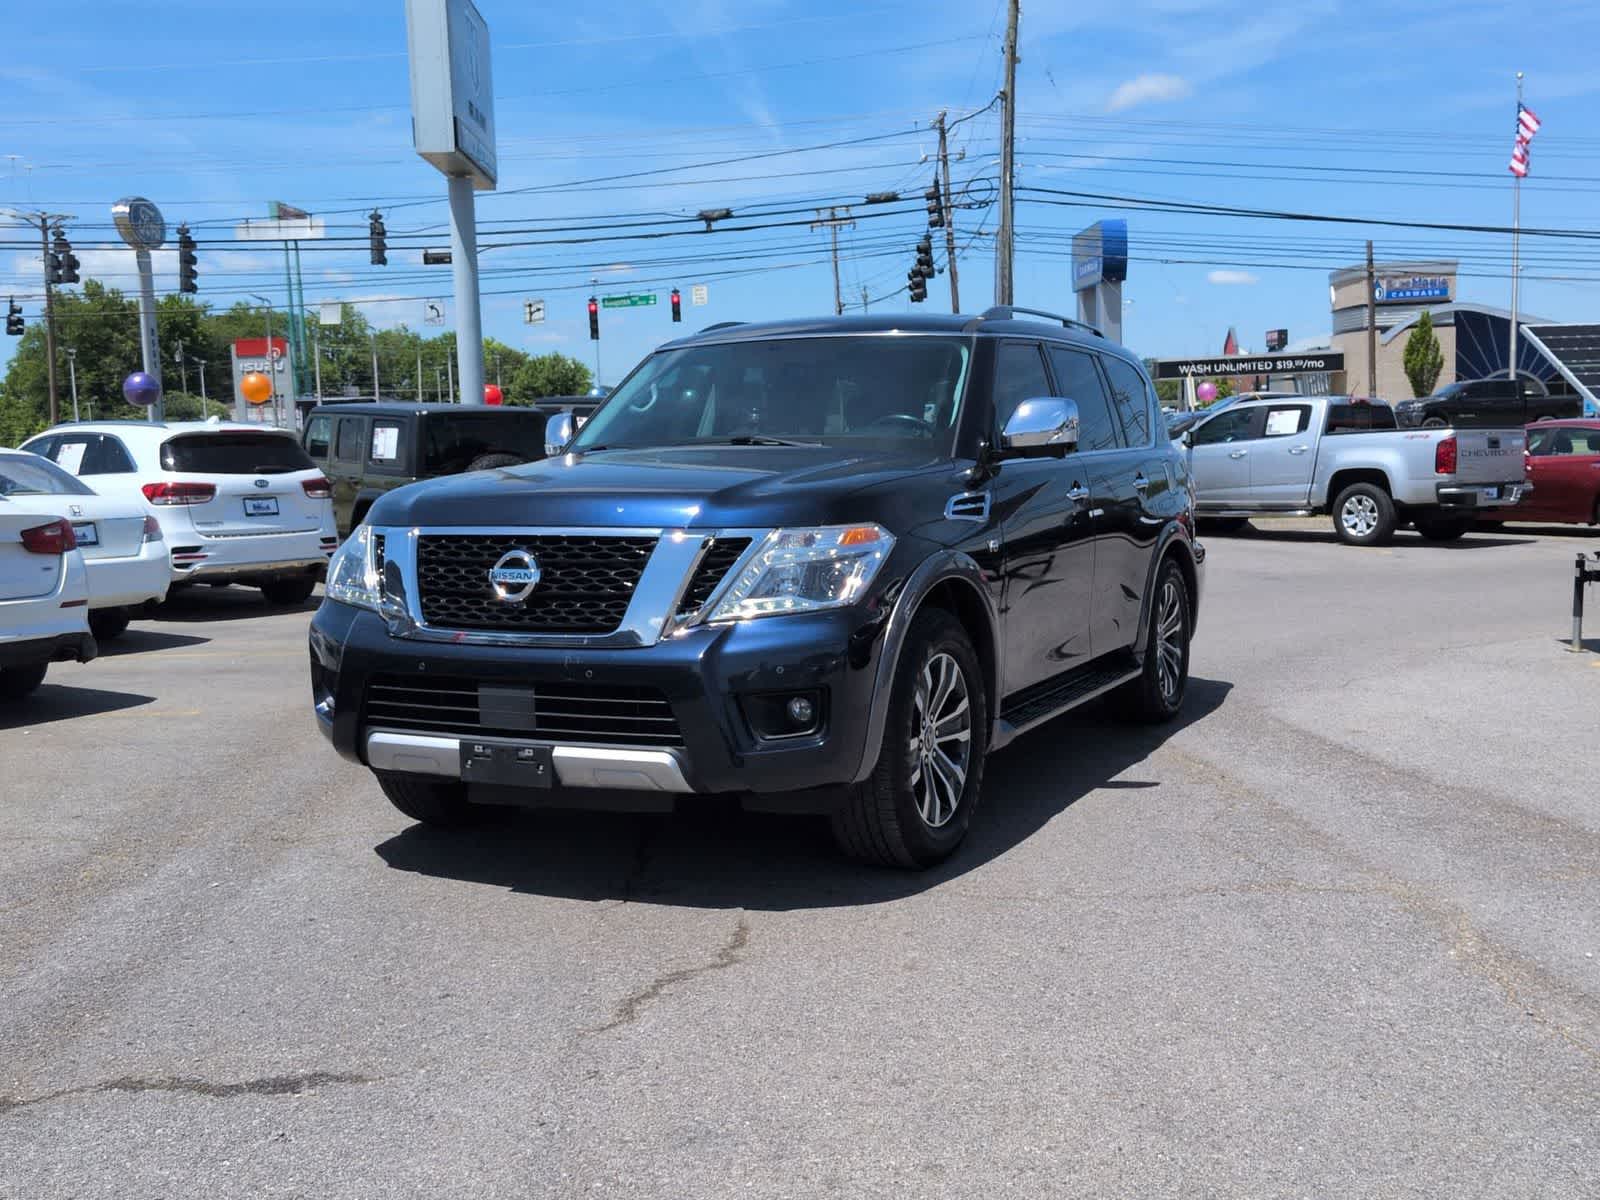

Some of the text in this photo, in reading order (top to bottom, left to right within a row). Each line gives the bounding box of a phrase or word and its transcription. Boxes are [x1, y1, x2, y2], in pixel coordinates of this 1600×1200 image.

[1391, 289, 1440, 298] CARWASH
[1178, 363, 1212, 375] WASH
[1214, 360, 1273, 374] UNLIMITED
[492, 571, 532, 580] NISSAN
